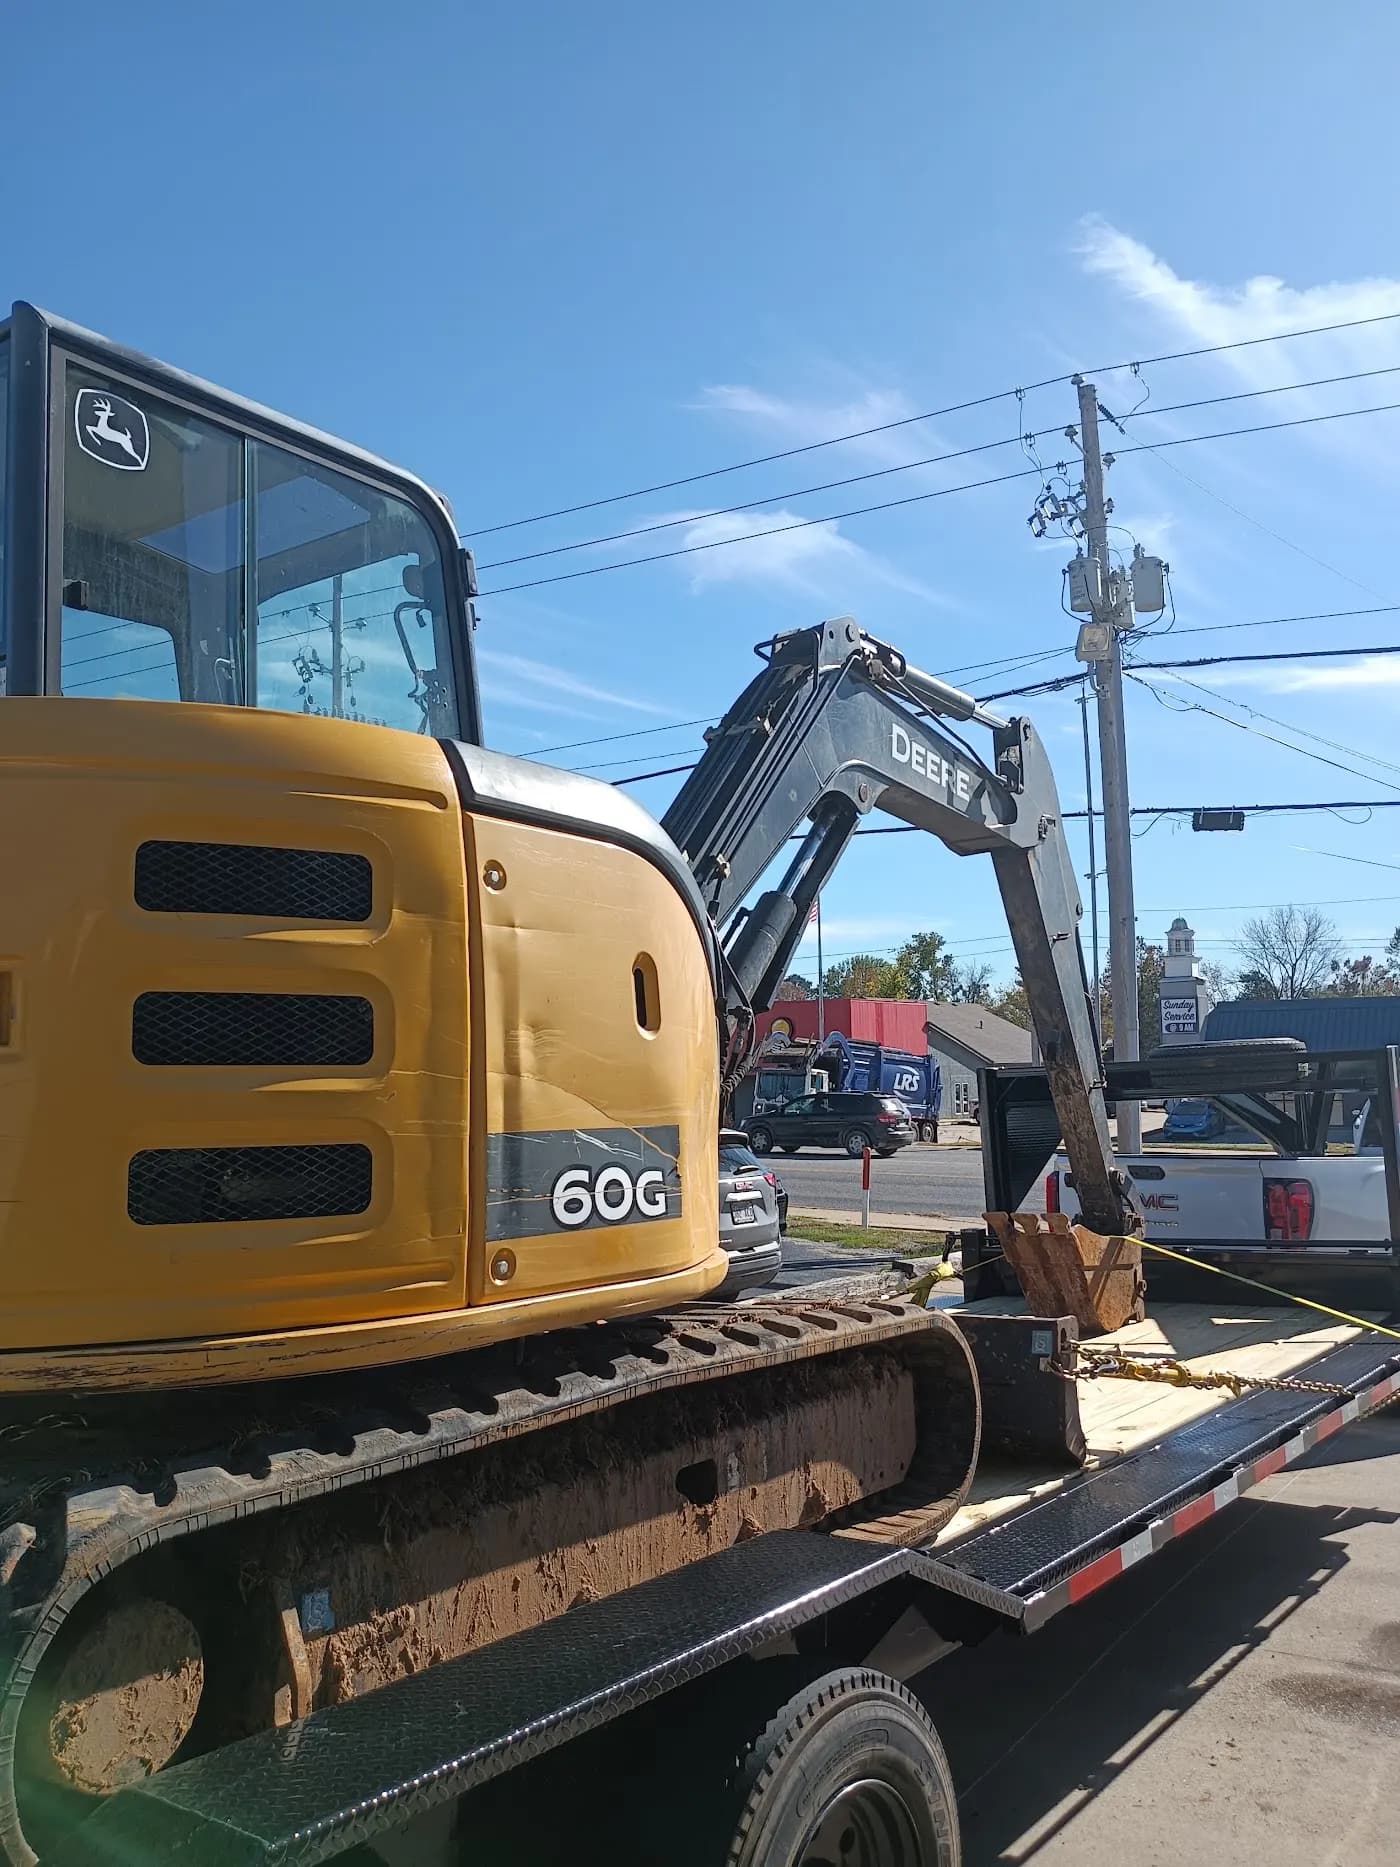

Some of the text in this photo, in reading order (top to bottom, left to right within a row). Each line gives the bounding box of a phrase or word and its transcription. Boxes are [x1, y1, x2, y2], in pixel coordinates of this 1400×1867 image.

[891, 722, 970, 801] DEERE
[1163, 999, 1194, 1012] Sunday
[1163, 1011, 1196, 1021] Service
[1178, 1023, 1184, 1032] 9
[1184, 1023, 1194, 1032] AM
[893, 1072, 921, 1092] LRS
[551, 1164, 668, 1227] 60G
[1139, 1193, 1179, 1211] MC
